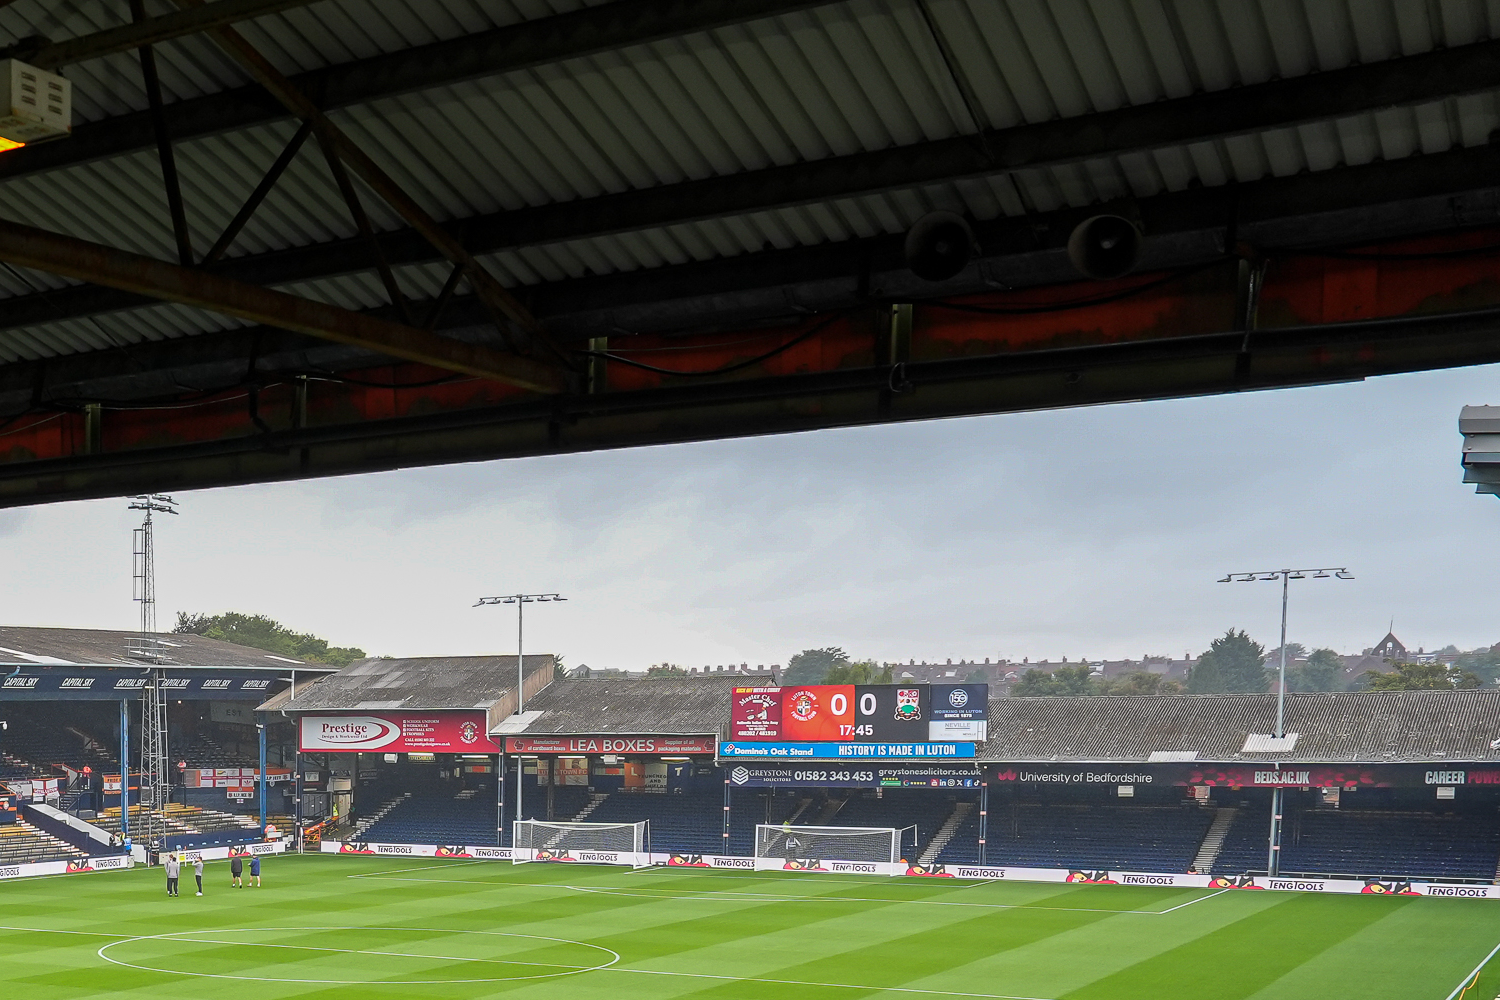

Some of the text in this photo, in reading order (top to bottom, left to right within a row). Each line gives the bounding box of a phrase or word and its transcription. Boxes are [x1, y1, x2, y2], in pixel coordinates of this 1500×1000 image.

[3, 678, 39, 687] CAPITAL SKY
[61, 678, 95, 687] CAPITAL SKY
[116, 678, 147, 687] CAPITAL SKY
[739, 694, 777, 707] Master Chef
[951, 694, 967, 703] 150
[830, 693, 877, 716] 0 0
[322, 723, 367, 734] Prestige
[839, 724, 873, 736] 17:45
[570, 740, 598, 751] LEA
[603, 740, 655, 751] BOXES
[839, 745, 956, 755] HISTORY IS MADE IN LUTON
[790, 748, 813, 756] Stand
[749, 769, 873, 781] GREYSTONE 01582 343 453
[878, 767, 981, 777] greystonesolicitors.co.uk
[1020, 771, 1152, 783] University of Bedfordshire
[1254, 771, 1310, 784] BEDS.AC.UK
[1425, 771, 1465, 784] CAREER
